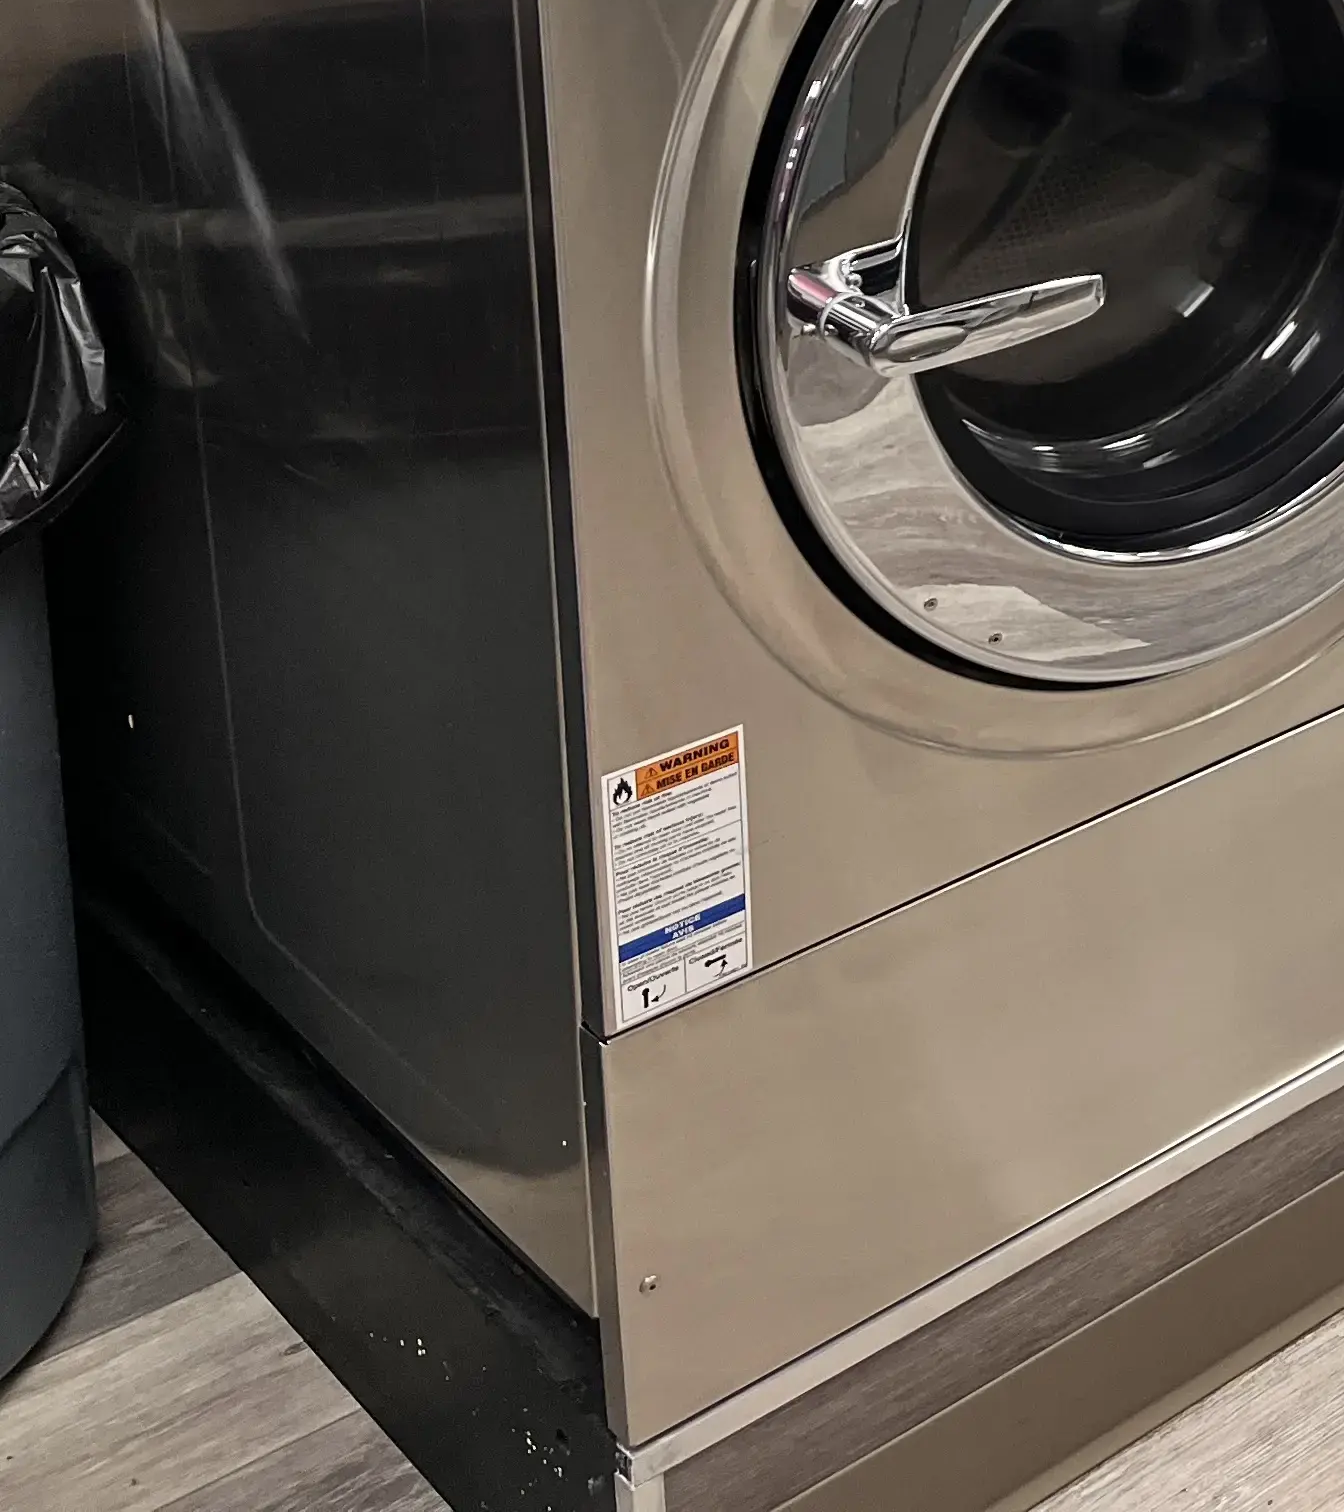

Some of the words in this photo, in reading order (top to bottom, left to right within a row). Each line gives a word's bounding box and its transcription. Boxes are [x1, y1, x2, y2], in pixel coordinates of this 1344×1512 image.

[659, 738, 730, 773] WARNING
[656, 772, 682, 791] MISE
[685, 764, 699, 779] EN
[664, 912, 702, 935] NOTICE
[671, 926, 695, 941] AVIS
